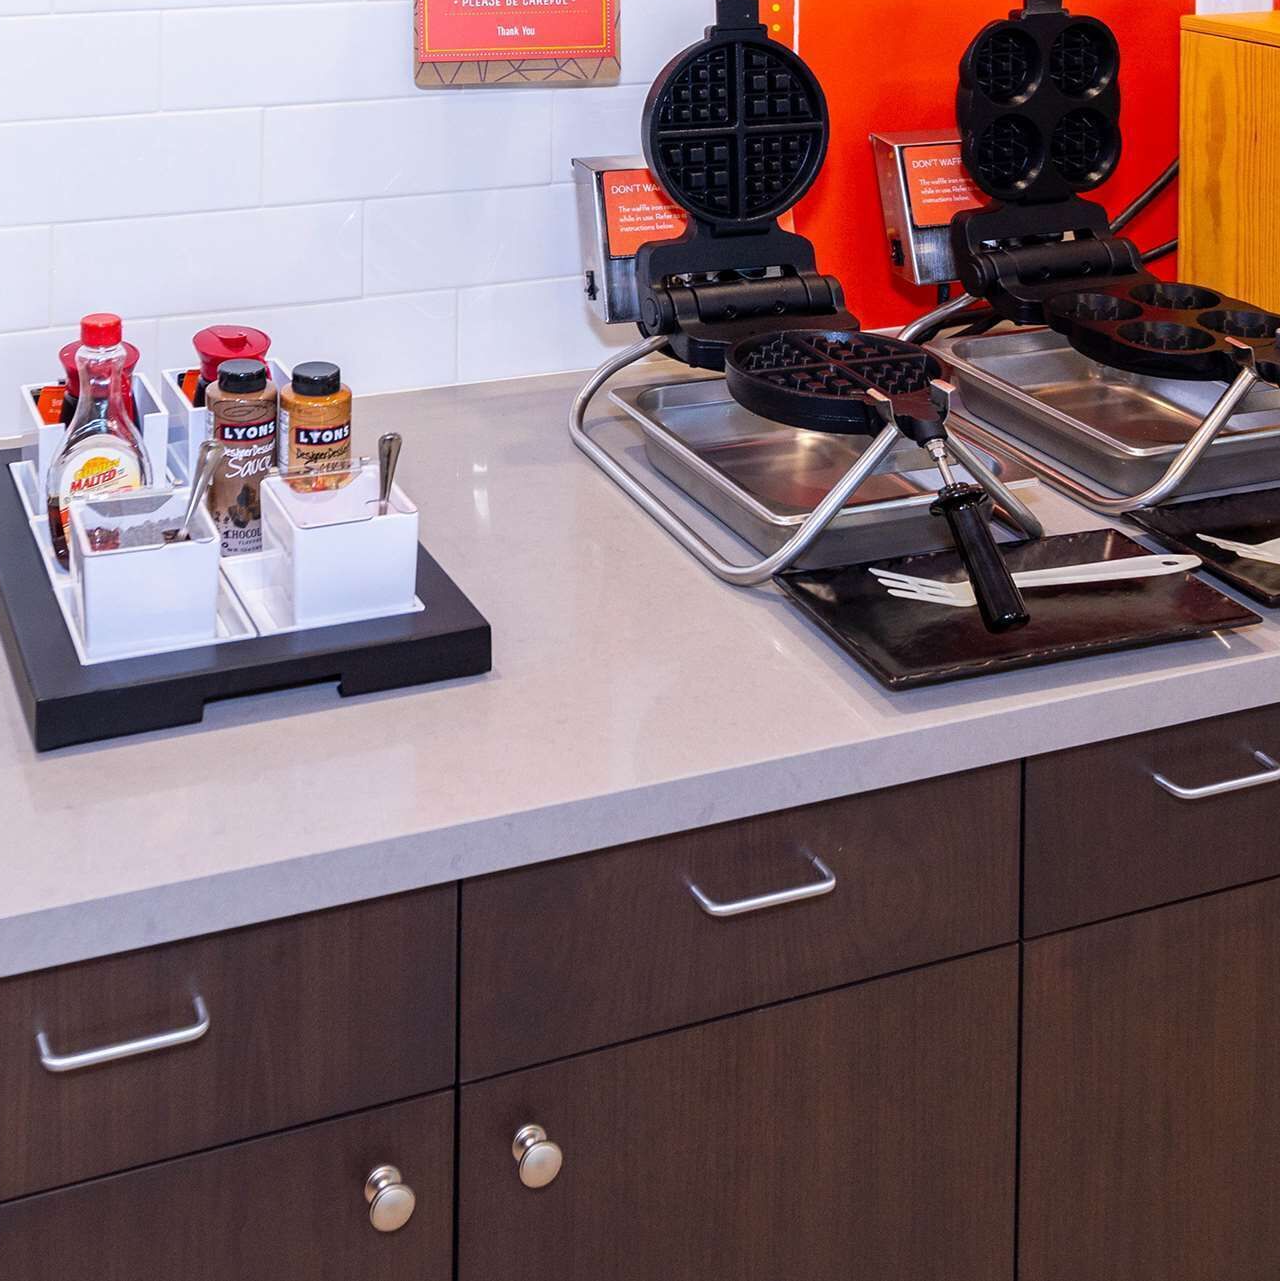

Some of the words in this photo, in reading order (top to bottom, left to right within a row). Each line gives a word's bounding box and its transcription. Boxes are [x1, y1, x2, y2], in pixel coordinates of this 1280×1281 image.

[496, 25, 519, 37] Thank
[522, 25, 535, 37] You
[611, 183, 640, 195] DON'T
[224, 421, 276, 440] LYONS
[299, 425, 350, 444] LYONS
[225, 455, 273, 479] Sauce
[70, 468, 117, 493] MALTED
